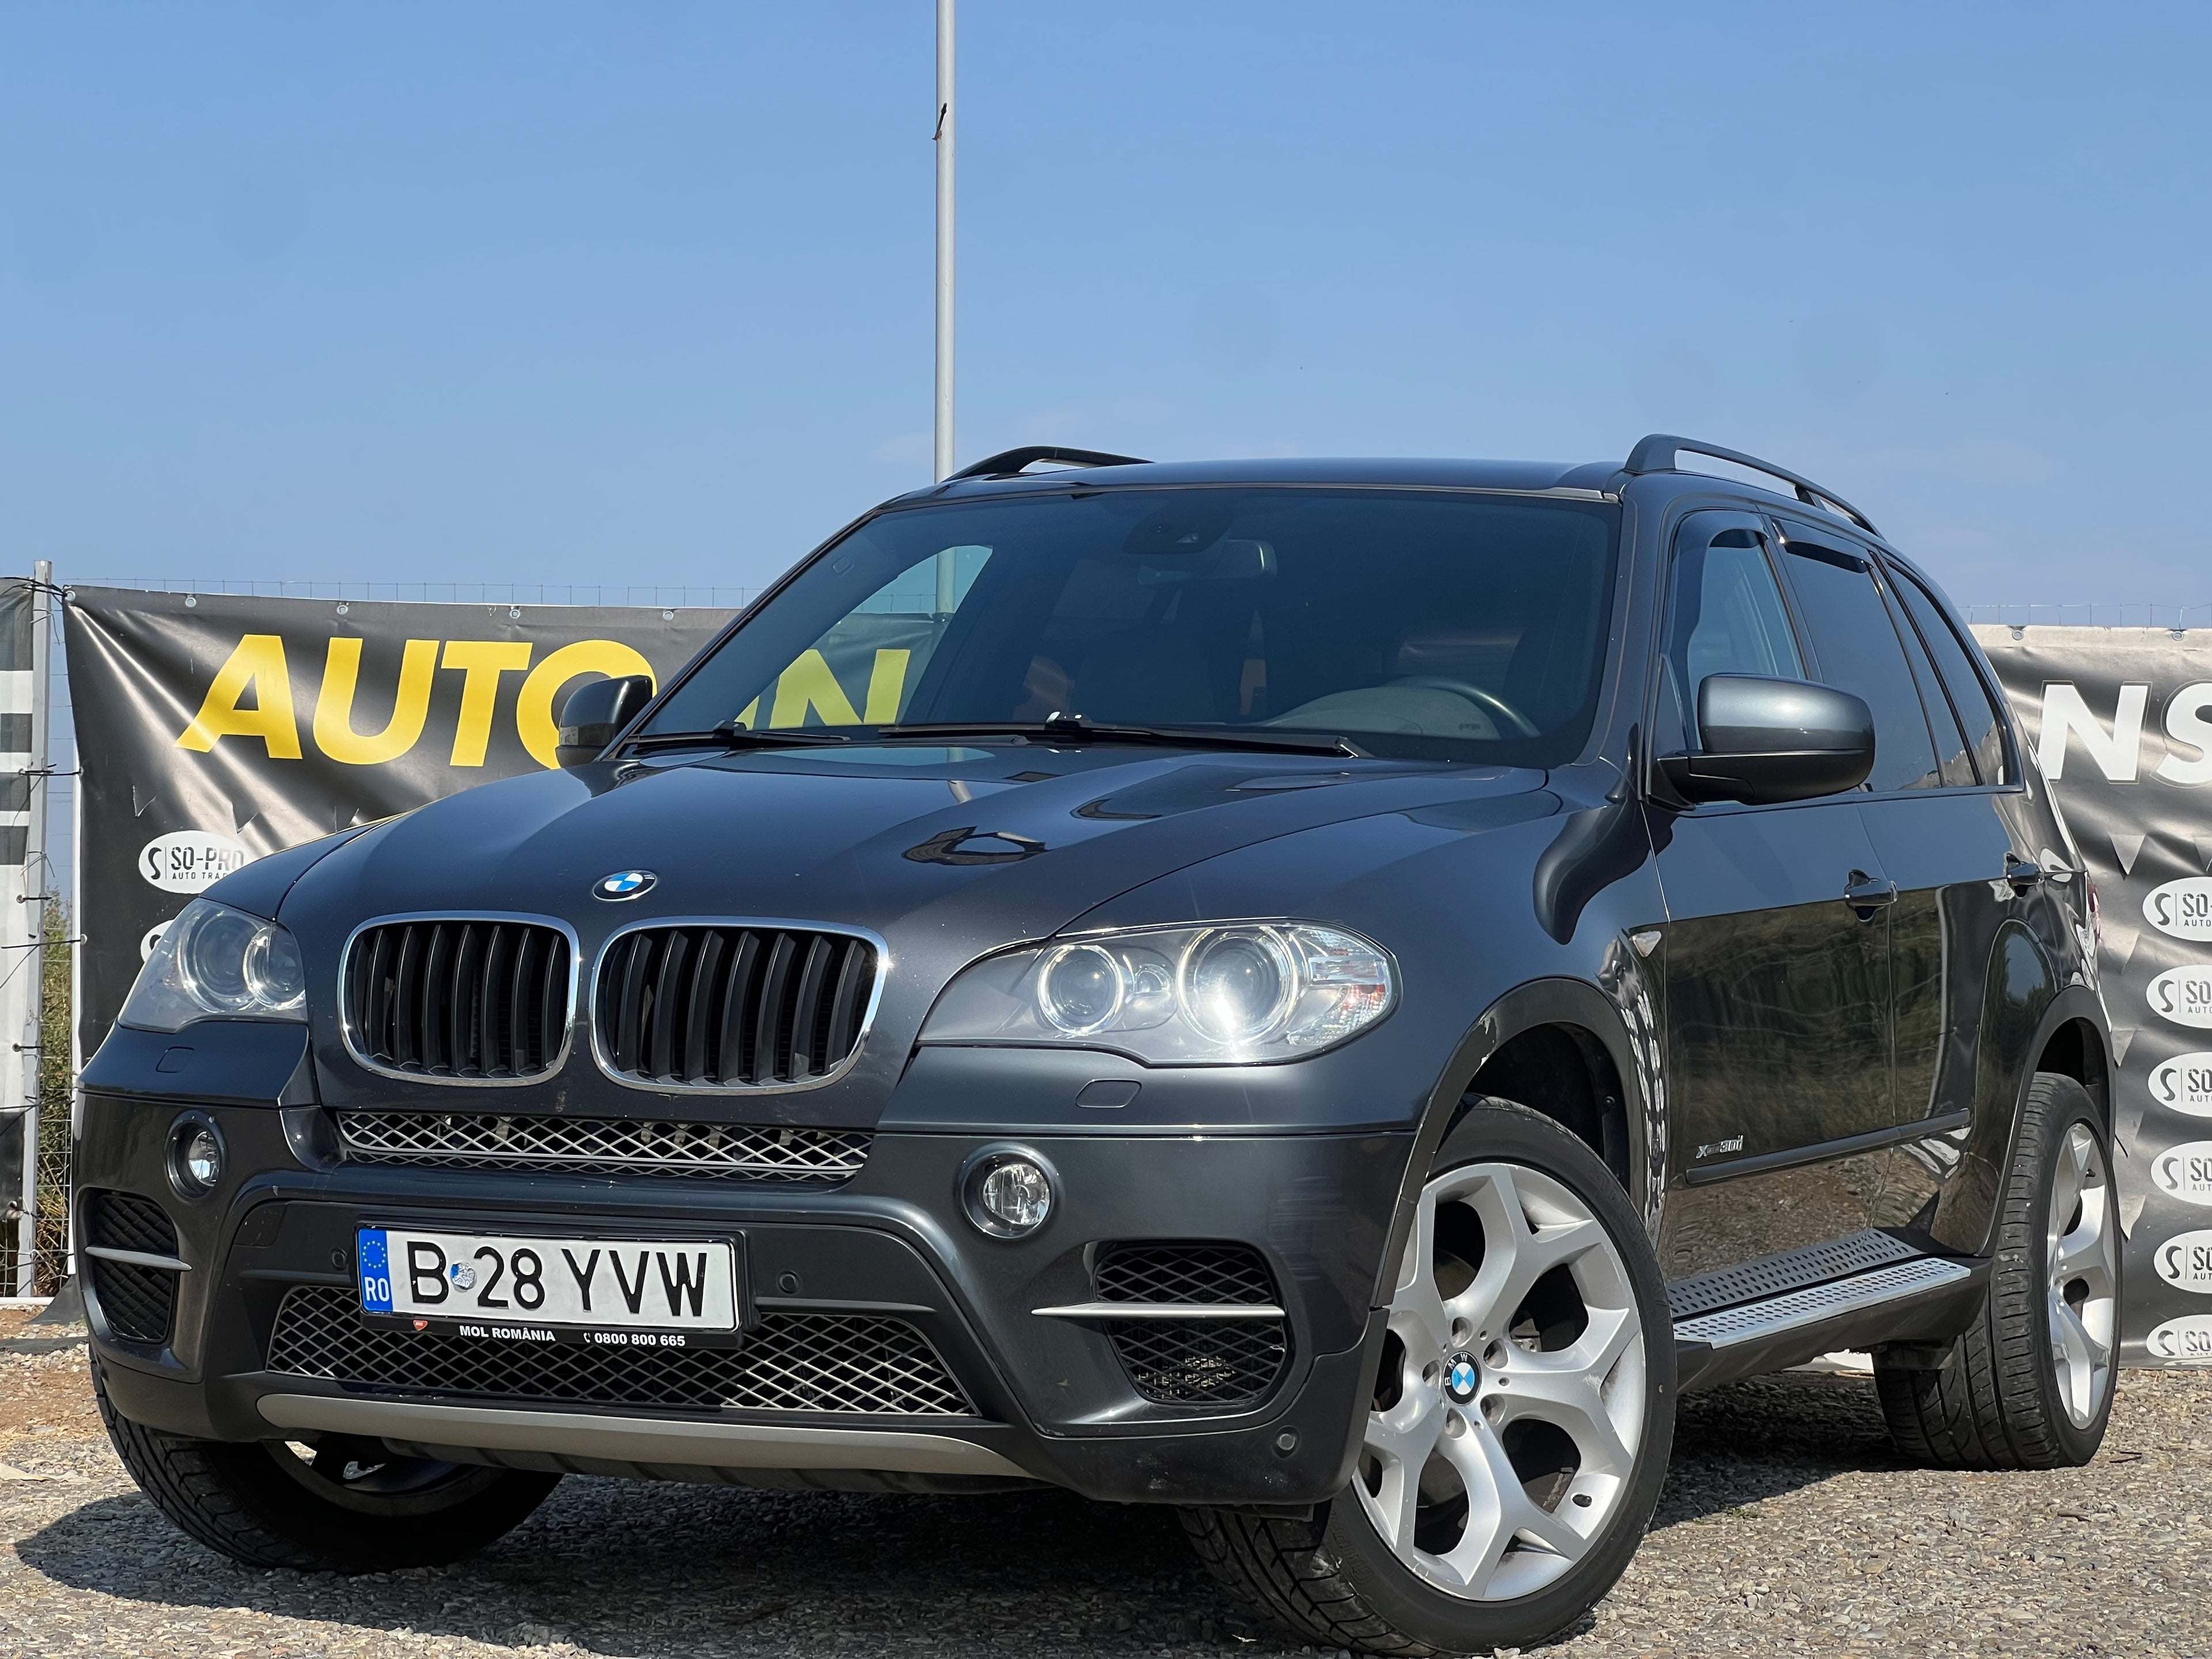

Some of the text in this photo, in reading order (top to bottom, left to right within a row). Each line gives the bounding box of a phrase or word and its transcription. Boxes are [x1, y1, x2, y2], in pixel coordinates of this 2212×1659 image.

[171, 846, 244, 871] SO-PRO
[172, 872, 196, 880] AUTO
[2182, 893, 2212, 918] SO
[2184, 919, 2211, 927] AUTO
[2186, 980, 2211, 1004] SO
[2188, 1068, 2212, 1093] SO
[2190, 1094, 2212, 1103] AUT
[364, 1277, 390, 1302] RO
[407, 1241, 449, 1304] B
[474, 1246, 546, 1309] 28
[560, 1248, 707, 1317] YVW
[459, 1325, 686, 1347] MOL ROMÂNIA 0800 800 665
[2184, 1330, 2211, 1352] SO
[1444, 1353, 1468, 1386] BMW
